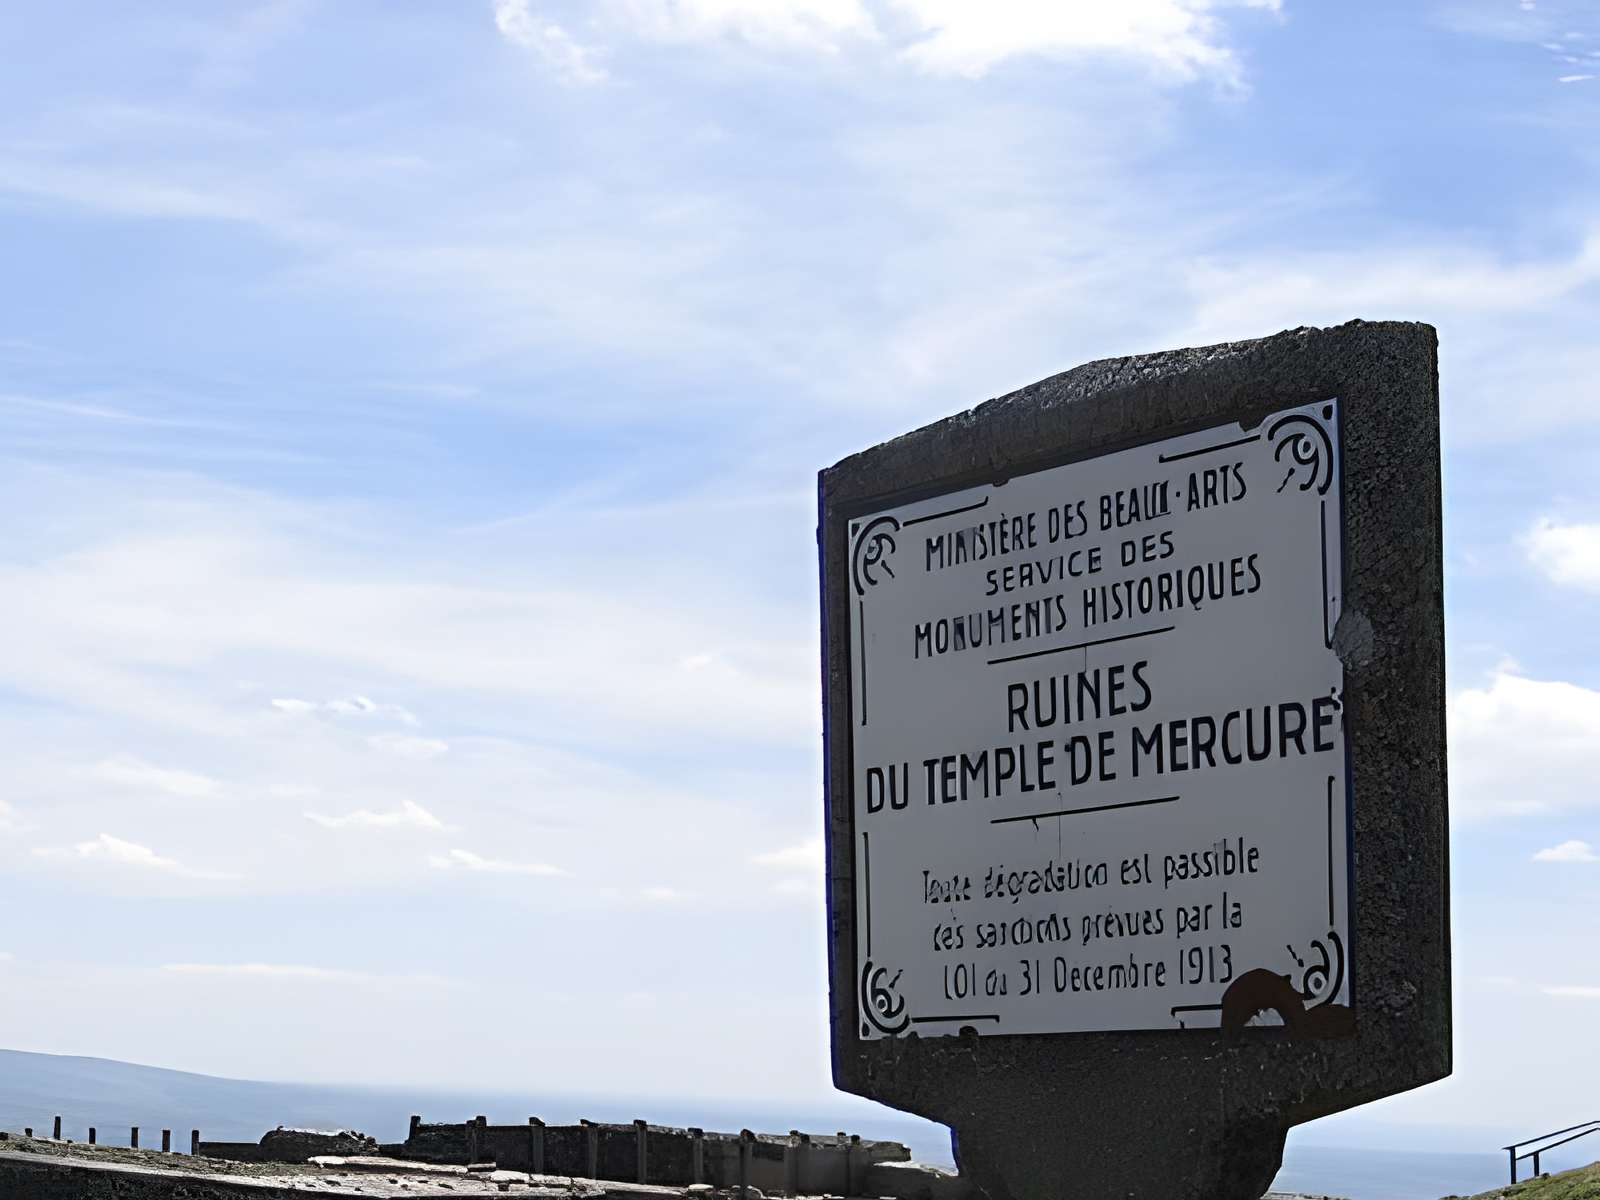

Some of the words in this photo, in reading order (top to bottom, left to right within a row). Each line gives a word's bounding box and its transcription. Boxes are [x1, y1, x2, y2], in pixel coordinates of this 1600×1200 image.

[926, 512, 1037, 572] MINISTÈRE
[1048, 500, 1087, 540] DES
[1187, 462, 1247, 512] ARTS
[986, 547, 1102, 596] SERVICE
[1121, 531, 1174, 567] DES
[914, 594, 1067, 659] MONUMENTS
[1084, 553, 1261, 628] HISTORIQUES
[1008, 661, 1152, 733] RUINES
[866, 763, 909, 814] DU
[923, 740, 1056, 806] TEMPLE
[1070, 731, 1116, 786] DE
[1132, 695, 1340, 778] MERCURE
[1164, 837, 1259, 889] passible
[1177, 904, 1213, 939] par
[1223, 892, 1242, 929] la
[1019, 959, 1041, 996] 31
[1180, 944, 1233, 985] 1913
